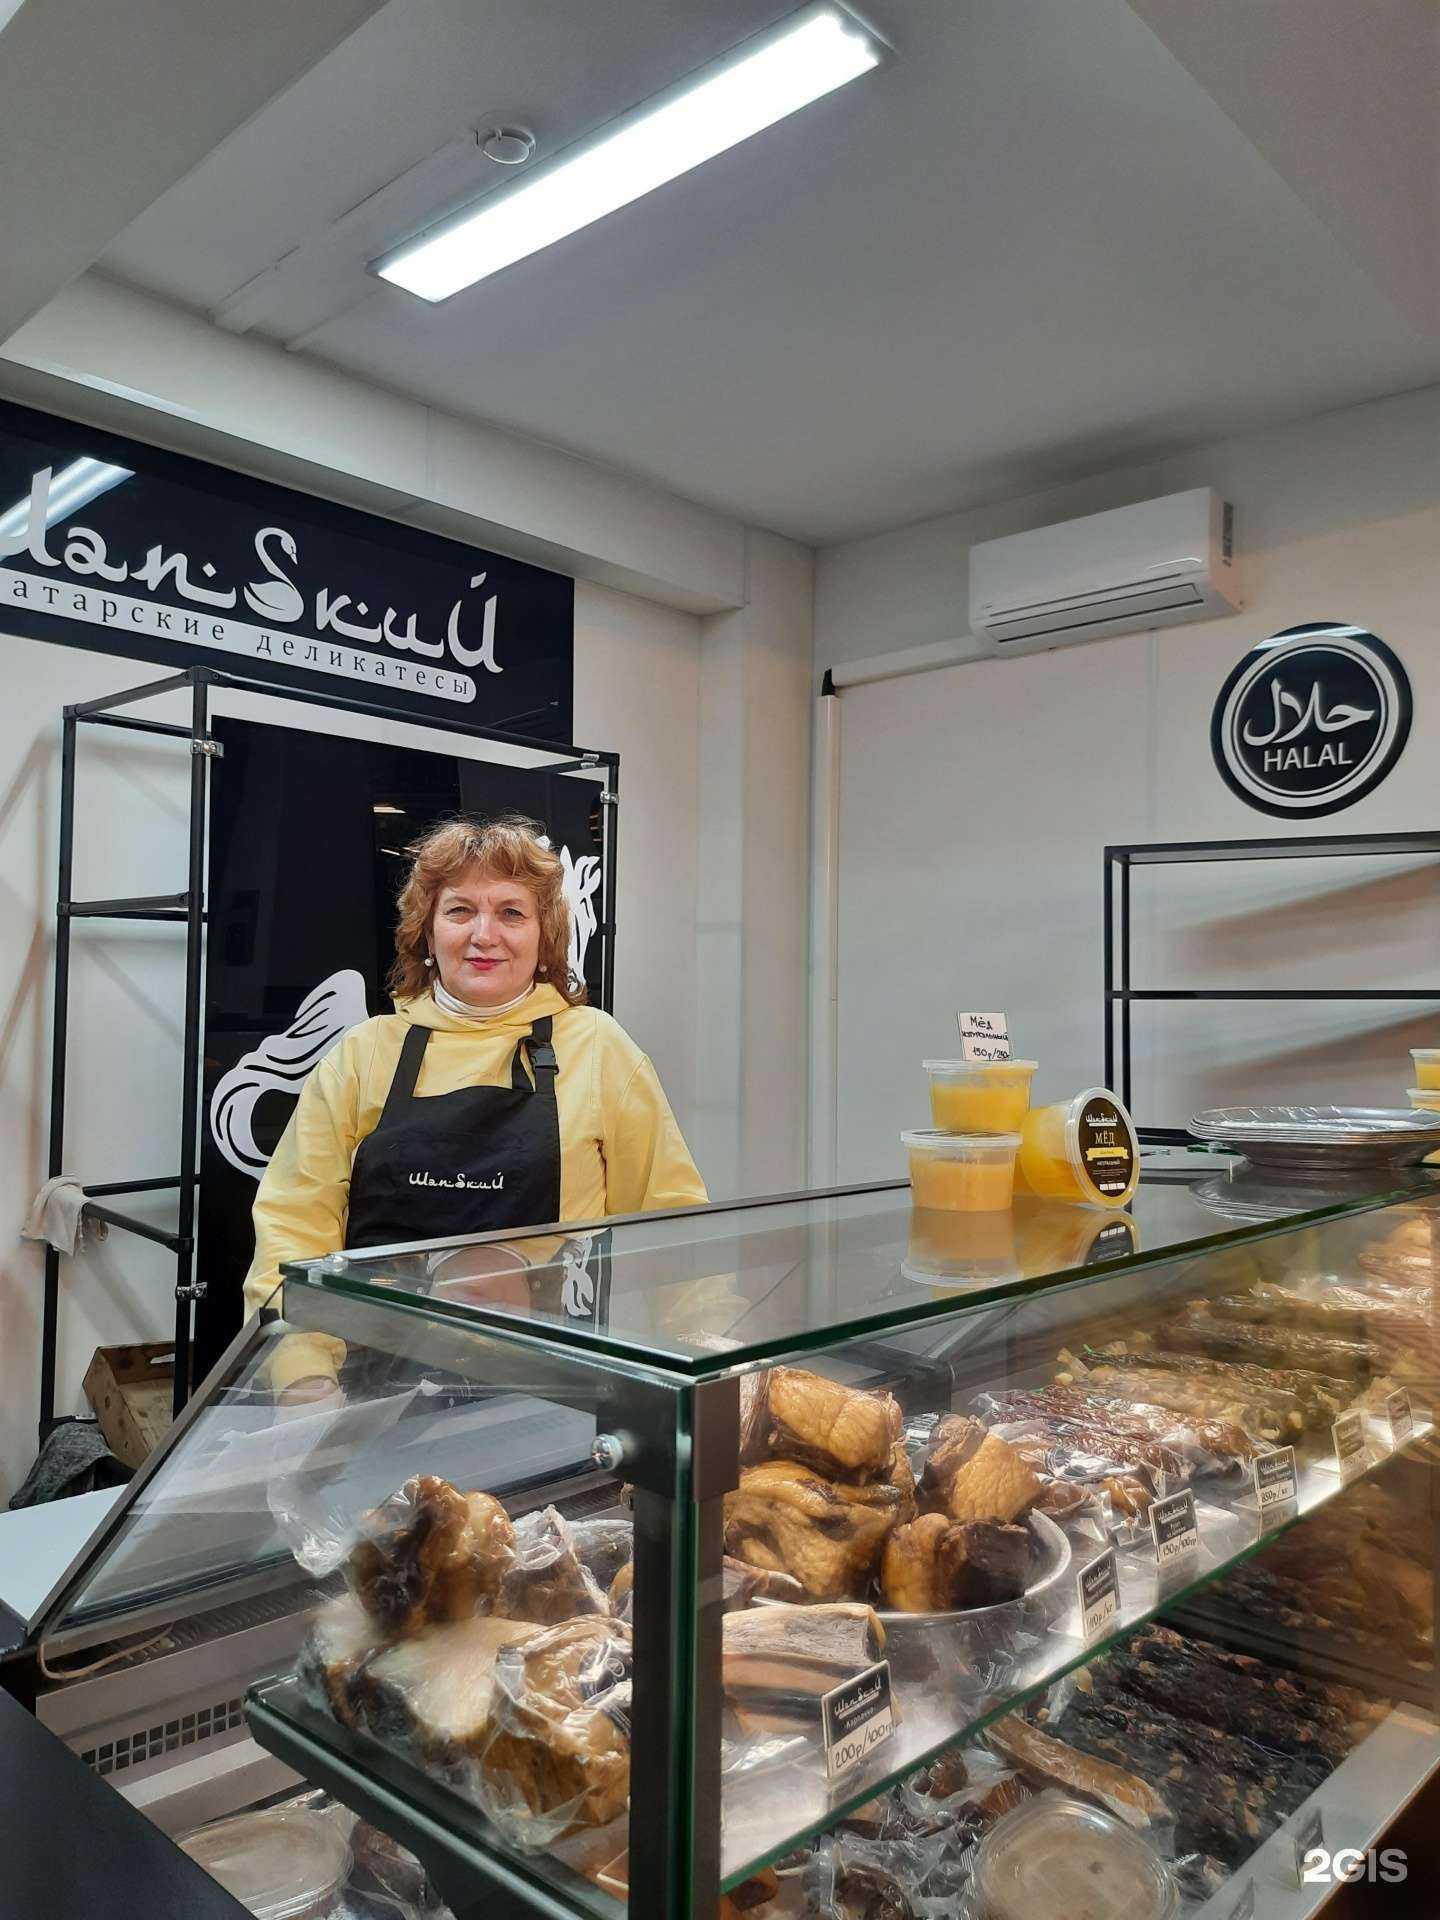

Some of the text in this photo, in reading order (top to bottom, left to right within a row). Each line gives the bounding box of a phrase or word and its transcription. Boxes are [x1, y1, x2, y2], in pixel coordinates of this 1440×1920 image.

[12, 580, 469, 696] атарские деликатесы
[1243, 678, 1375, 746] حلال
[1263, 742, 1353, 772] HALAL
[1095, 1130, 1116, 1146] МЁД
